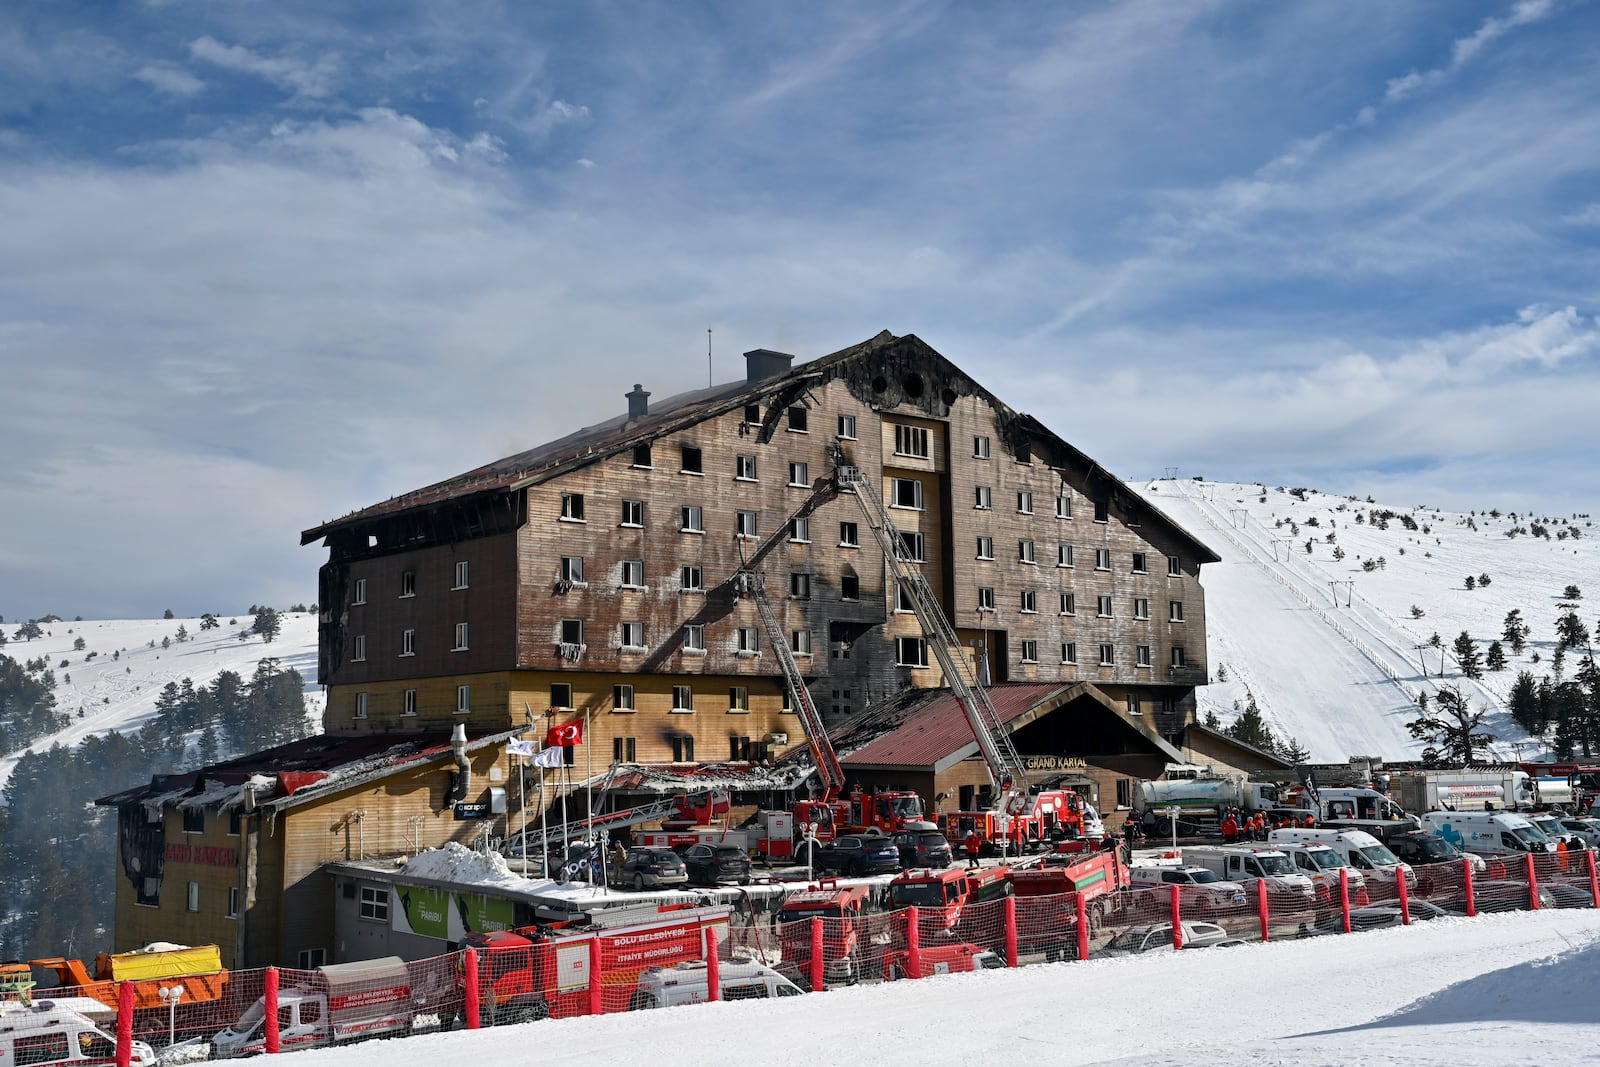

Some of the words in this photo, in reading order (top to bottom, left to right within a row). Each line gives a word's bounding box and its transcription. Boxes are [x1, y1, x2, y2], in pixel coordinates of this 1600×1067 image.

[1027, 757, 1056, 769] GRAND
[1057, 756, 1088, 768] KARTAL
[194, 846, 238, 867] KARTAL
[421, 910, 442, 922] PARIBU
[482, 920, 506, 932] PARIBU
[614, 936, 637, 946] BOLU
[639, 927, 685, 942] BELEDİYESİ
[617, 951, 642, 962] İTFAİYE
[644, 945, 683, 958] MÜDÜRLÜĞÜ
